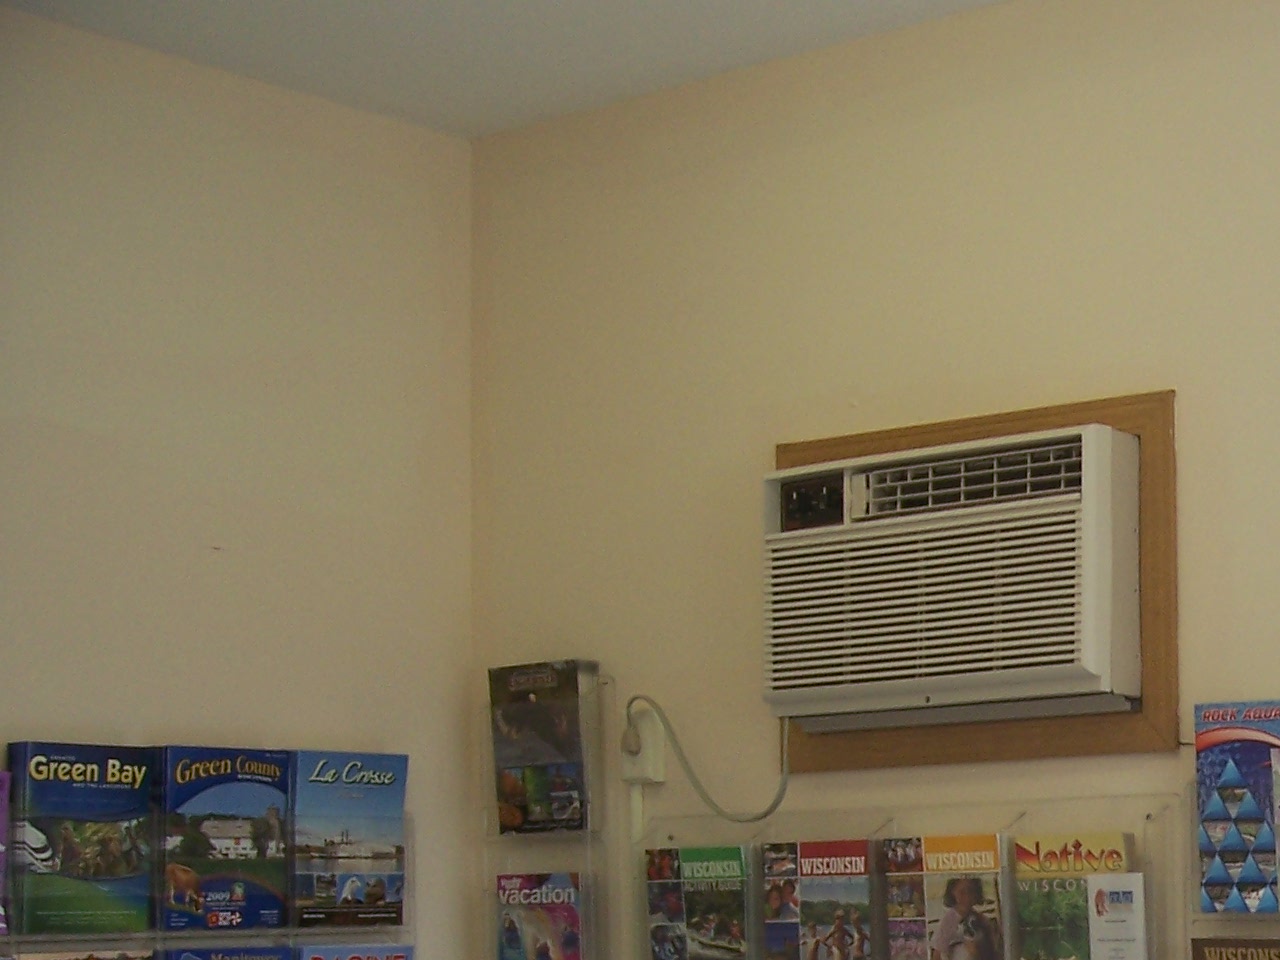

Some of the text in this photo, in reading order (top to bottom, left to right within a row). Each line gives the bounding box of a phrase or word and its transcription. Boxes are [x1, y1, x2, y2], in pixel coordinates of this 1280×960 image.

[1201, 708, 1238, 723] ROCK
[29, 754, 148, 790] Green Bay
[175, 754, 284, 784] Green County
[308, 759, 396, 786] La Crosse
[800, 855, 867, 875] WISCONSIN
[925, 851, 995, 870] WISCONSIN
[1014, 838, 1124, 872] Native
[682, 860, 742, 879] WISCONSIN
[205, 891, 231, 902] 2009
[498, 884, 576, 905] vacation
